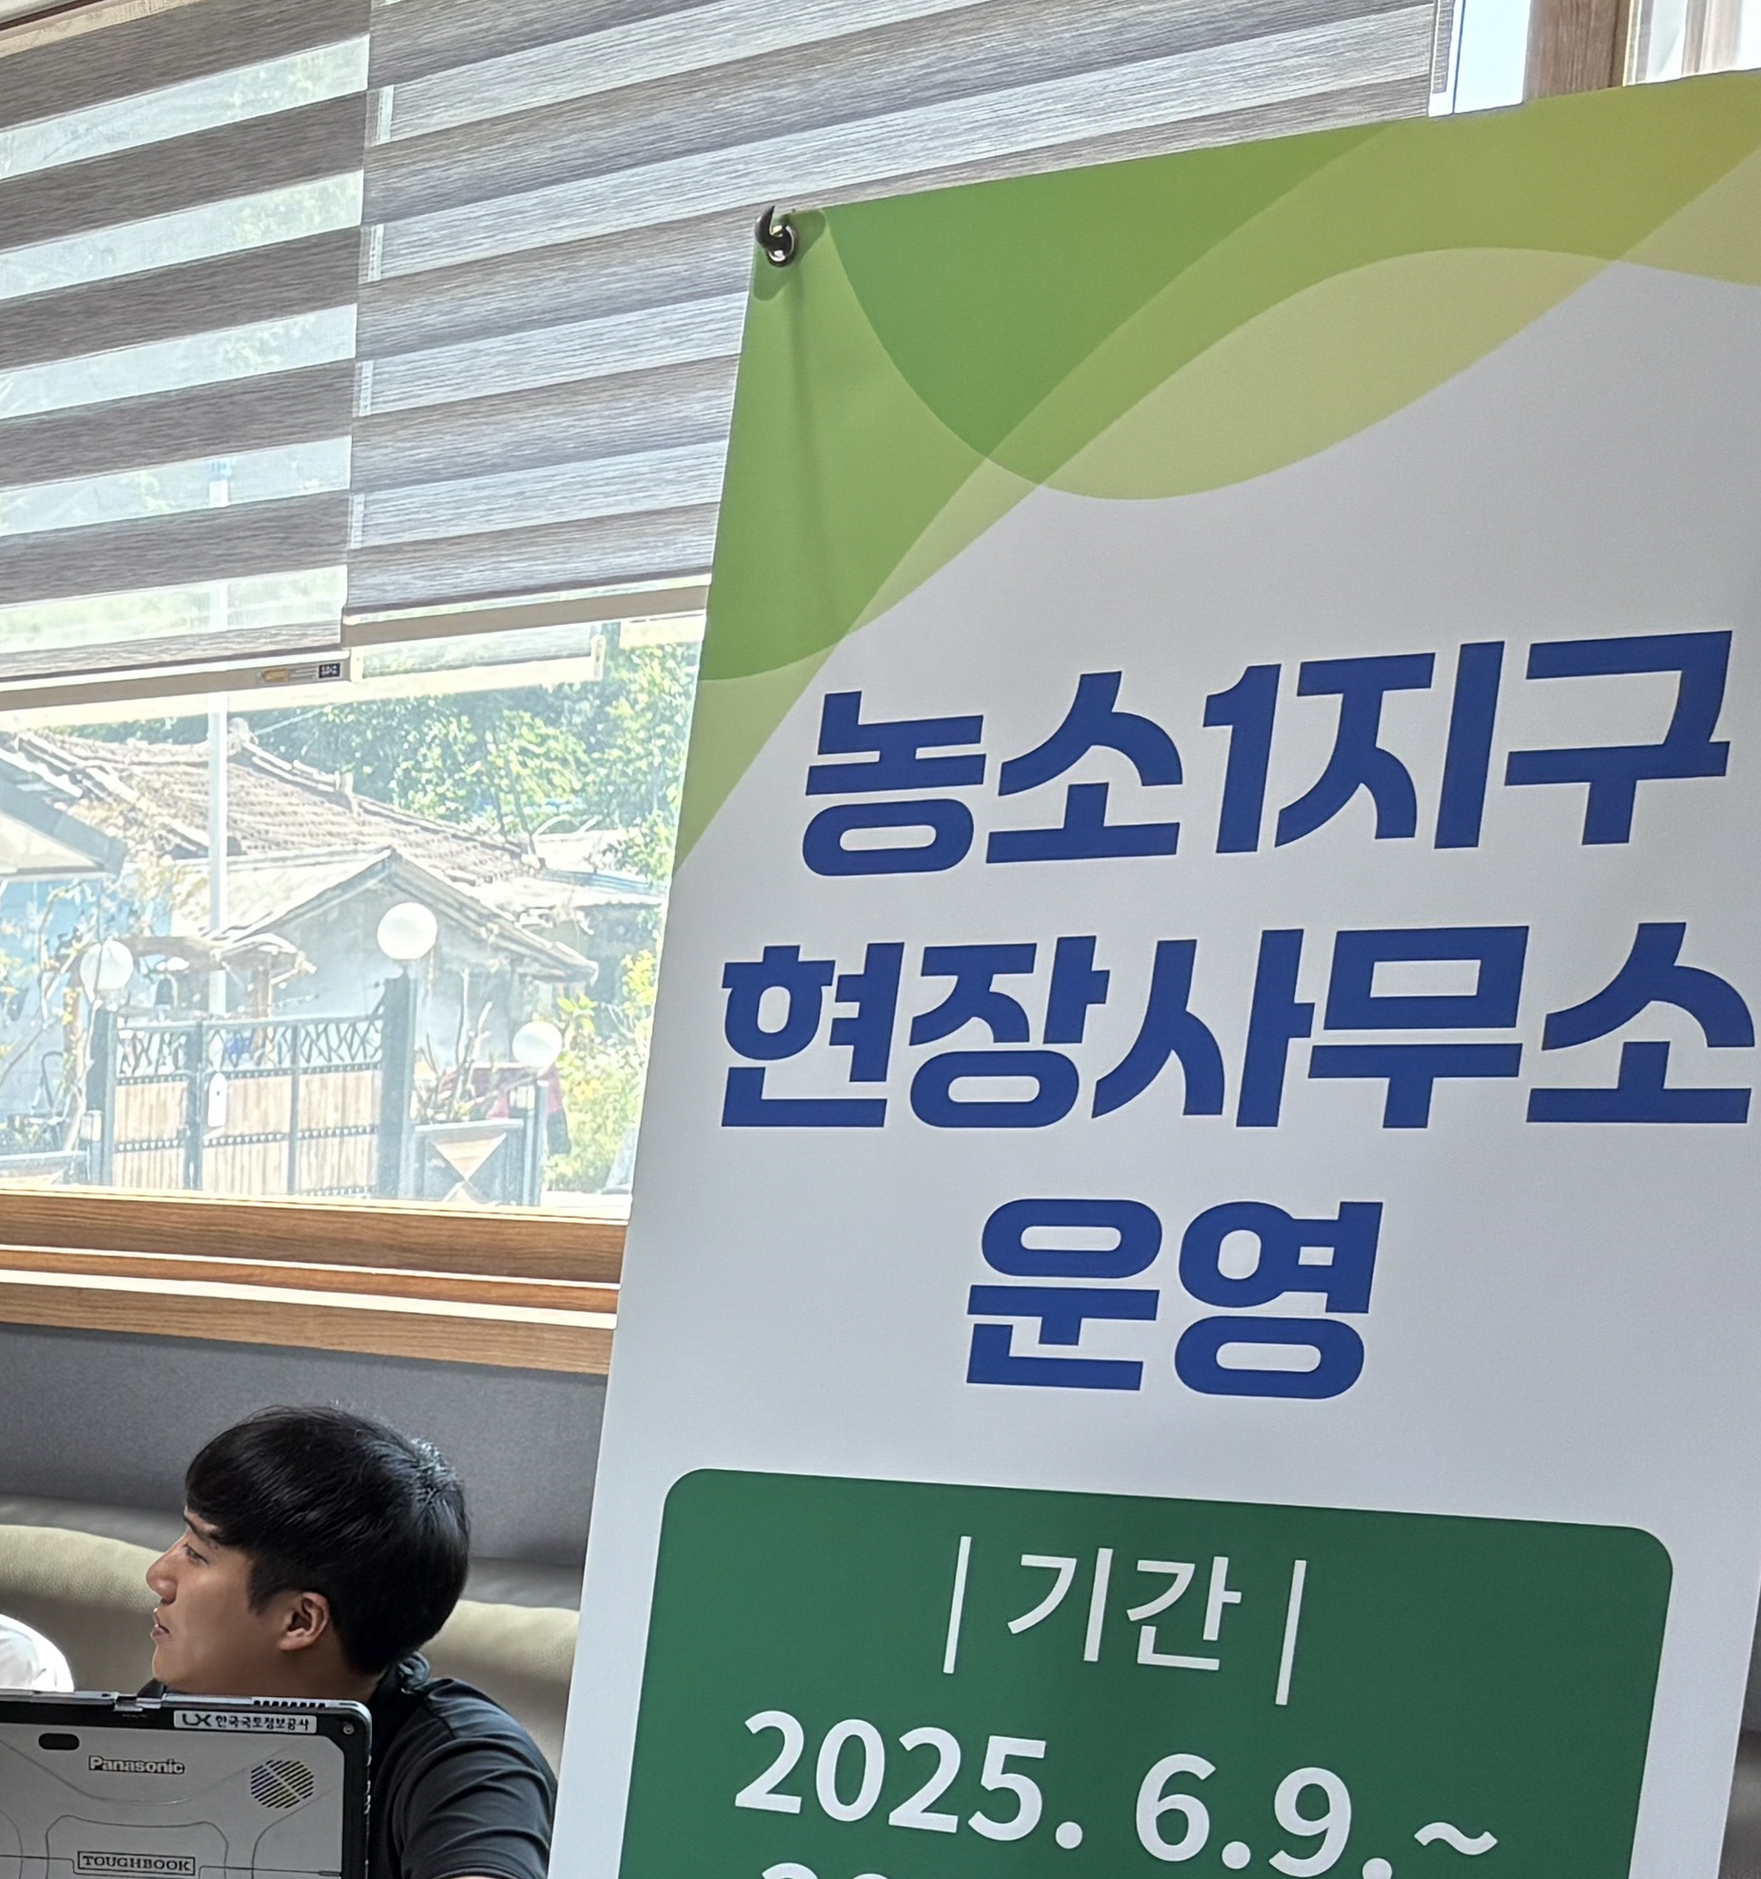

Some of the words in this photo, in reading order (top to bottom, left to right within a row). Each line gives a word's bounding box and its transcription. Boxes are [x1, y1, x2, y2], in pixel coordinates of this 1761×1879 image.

[802, 630, 1734, 877] 농소1지구
[720, 922, 1757, 1131] 현장사무소
[965, 1197, 1384, 1401] 운영
[1006, 1546, 1243, 1675] 기간
[88, 1755, 185, 1775] Panasonic
[733, 1709, 1085, 1851] 2025.
[81, 1854, 192, 1873] TOUGHBOOK
